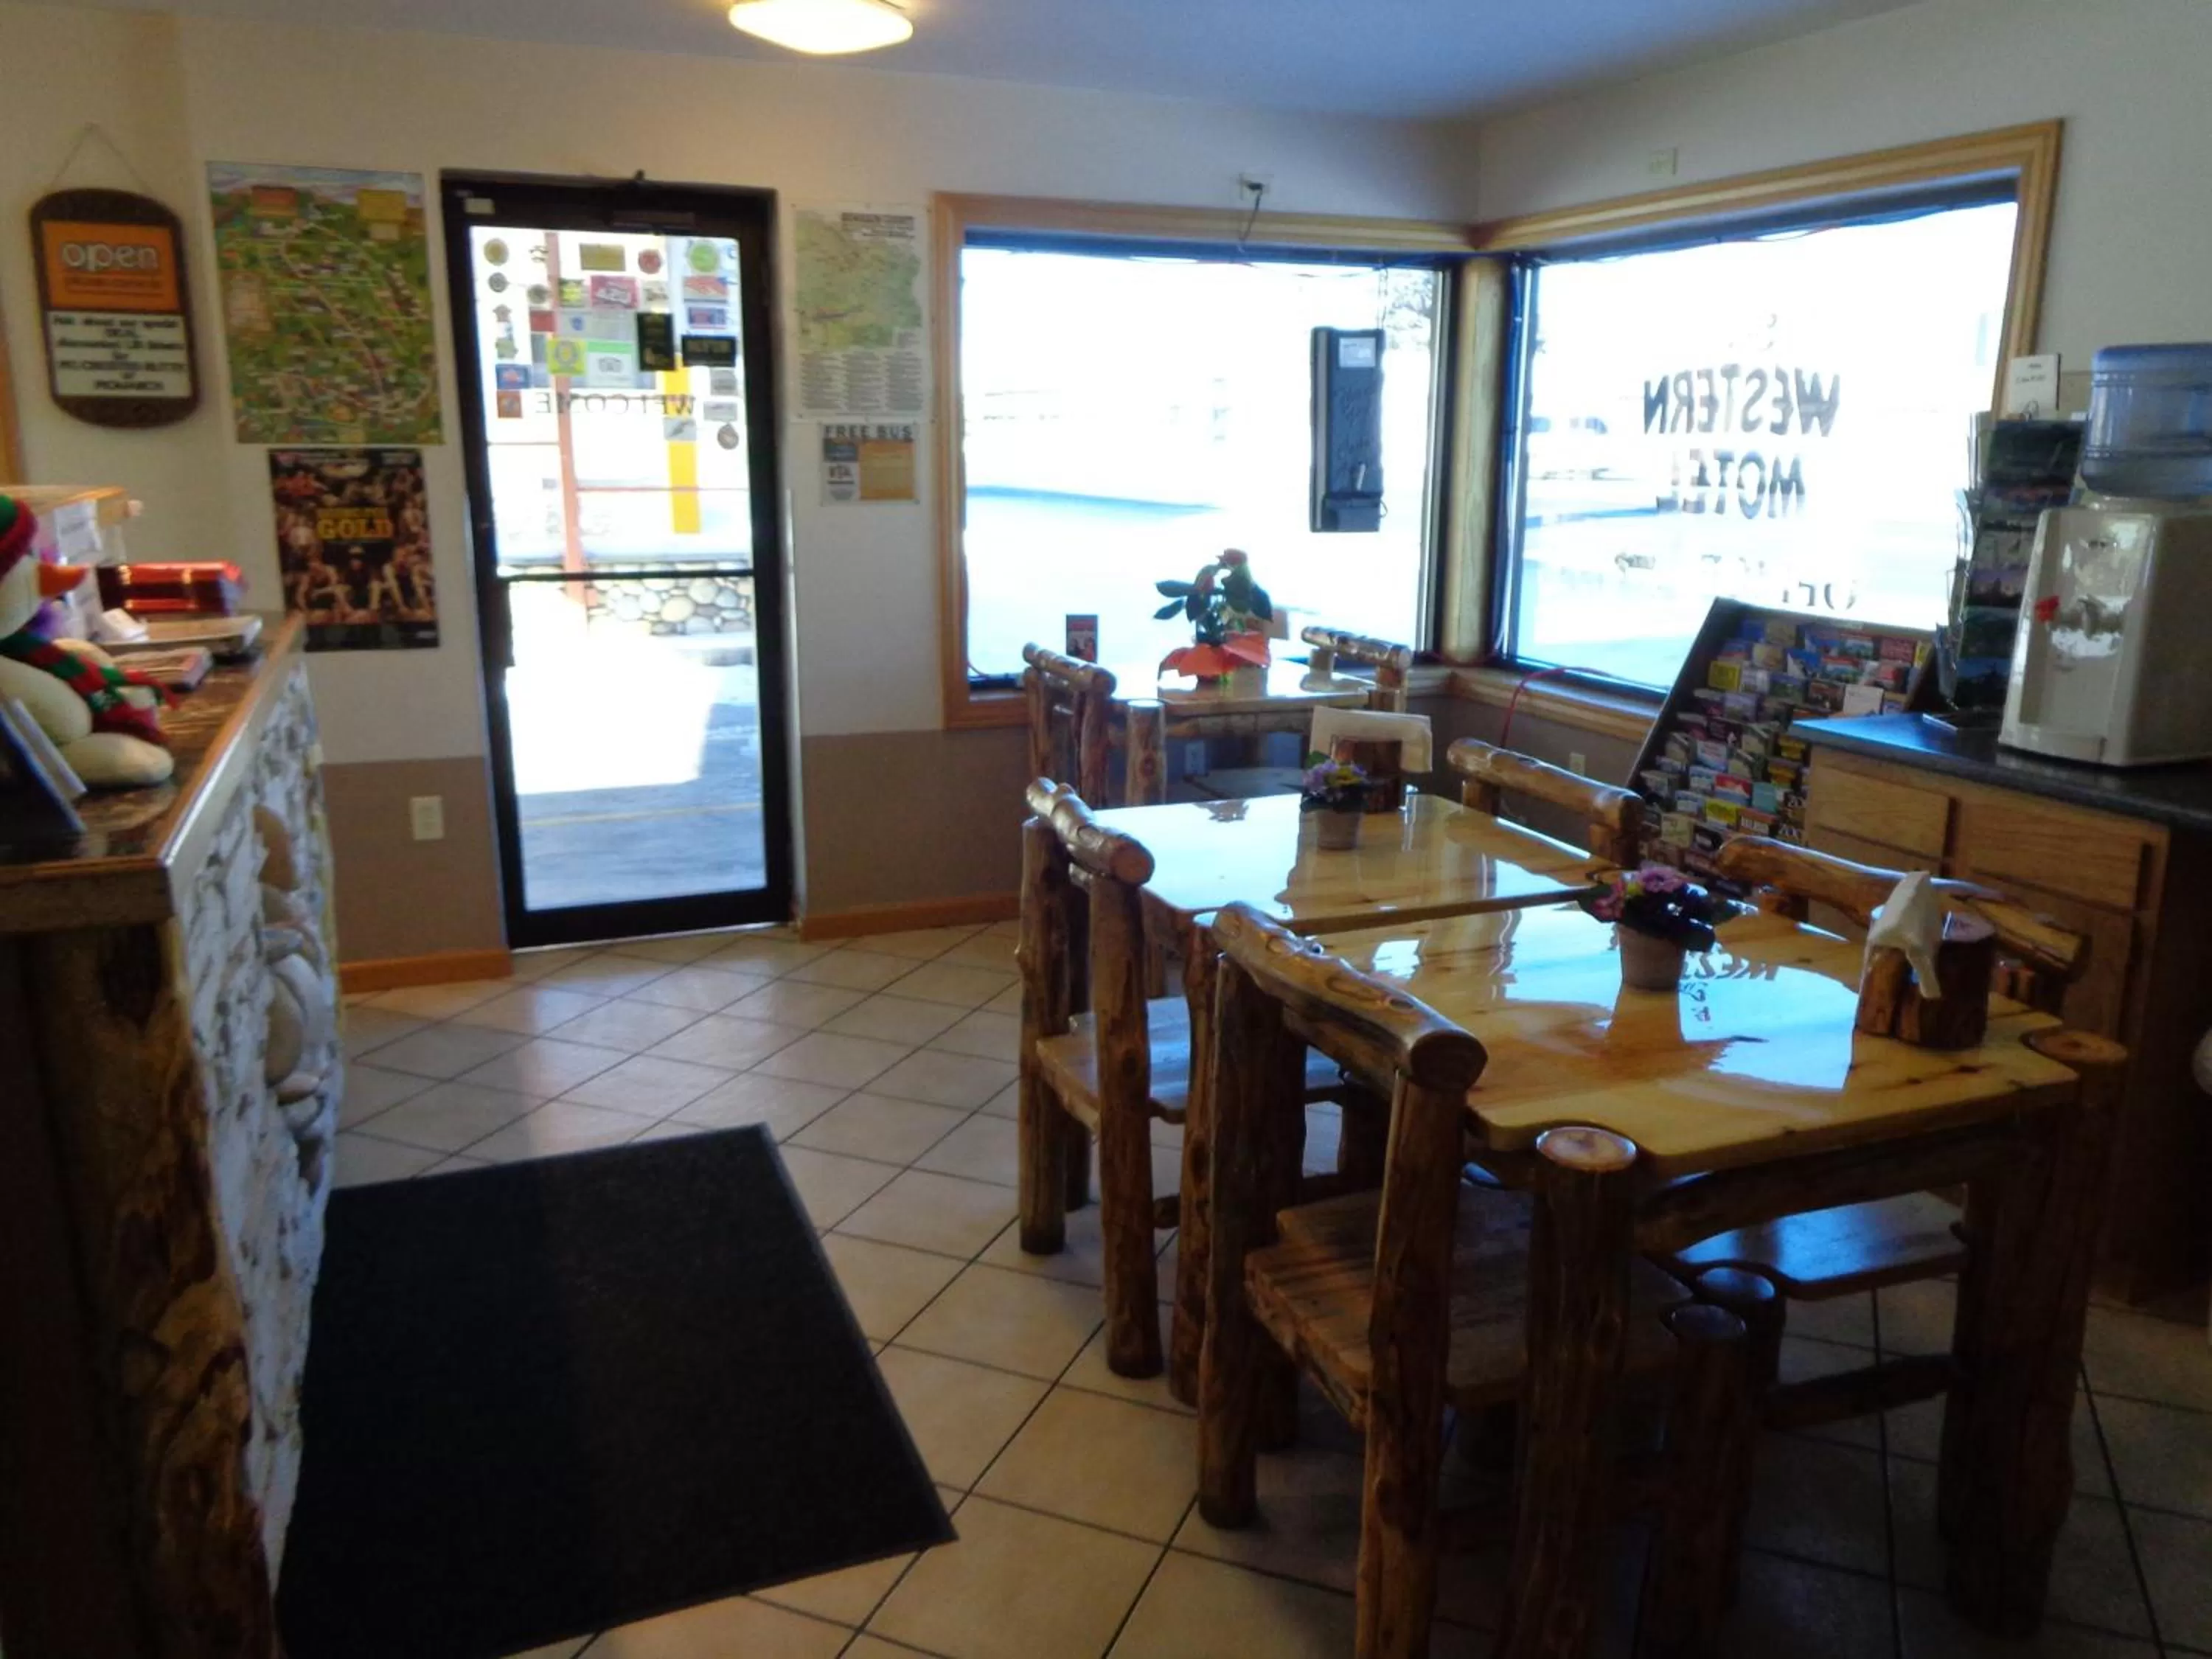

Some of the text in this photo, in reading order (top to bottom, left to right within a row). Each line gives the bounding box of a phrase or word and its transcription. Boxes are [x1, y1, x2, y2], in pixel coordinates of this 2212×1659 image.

[61, 242, 159, 272] open
[877, 424, 913, 440] BUS
[316, 518, 394, 540] GOLD
